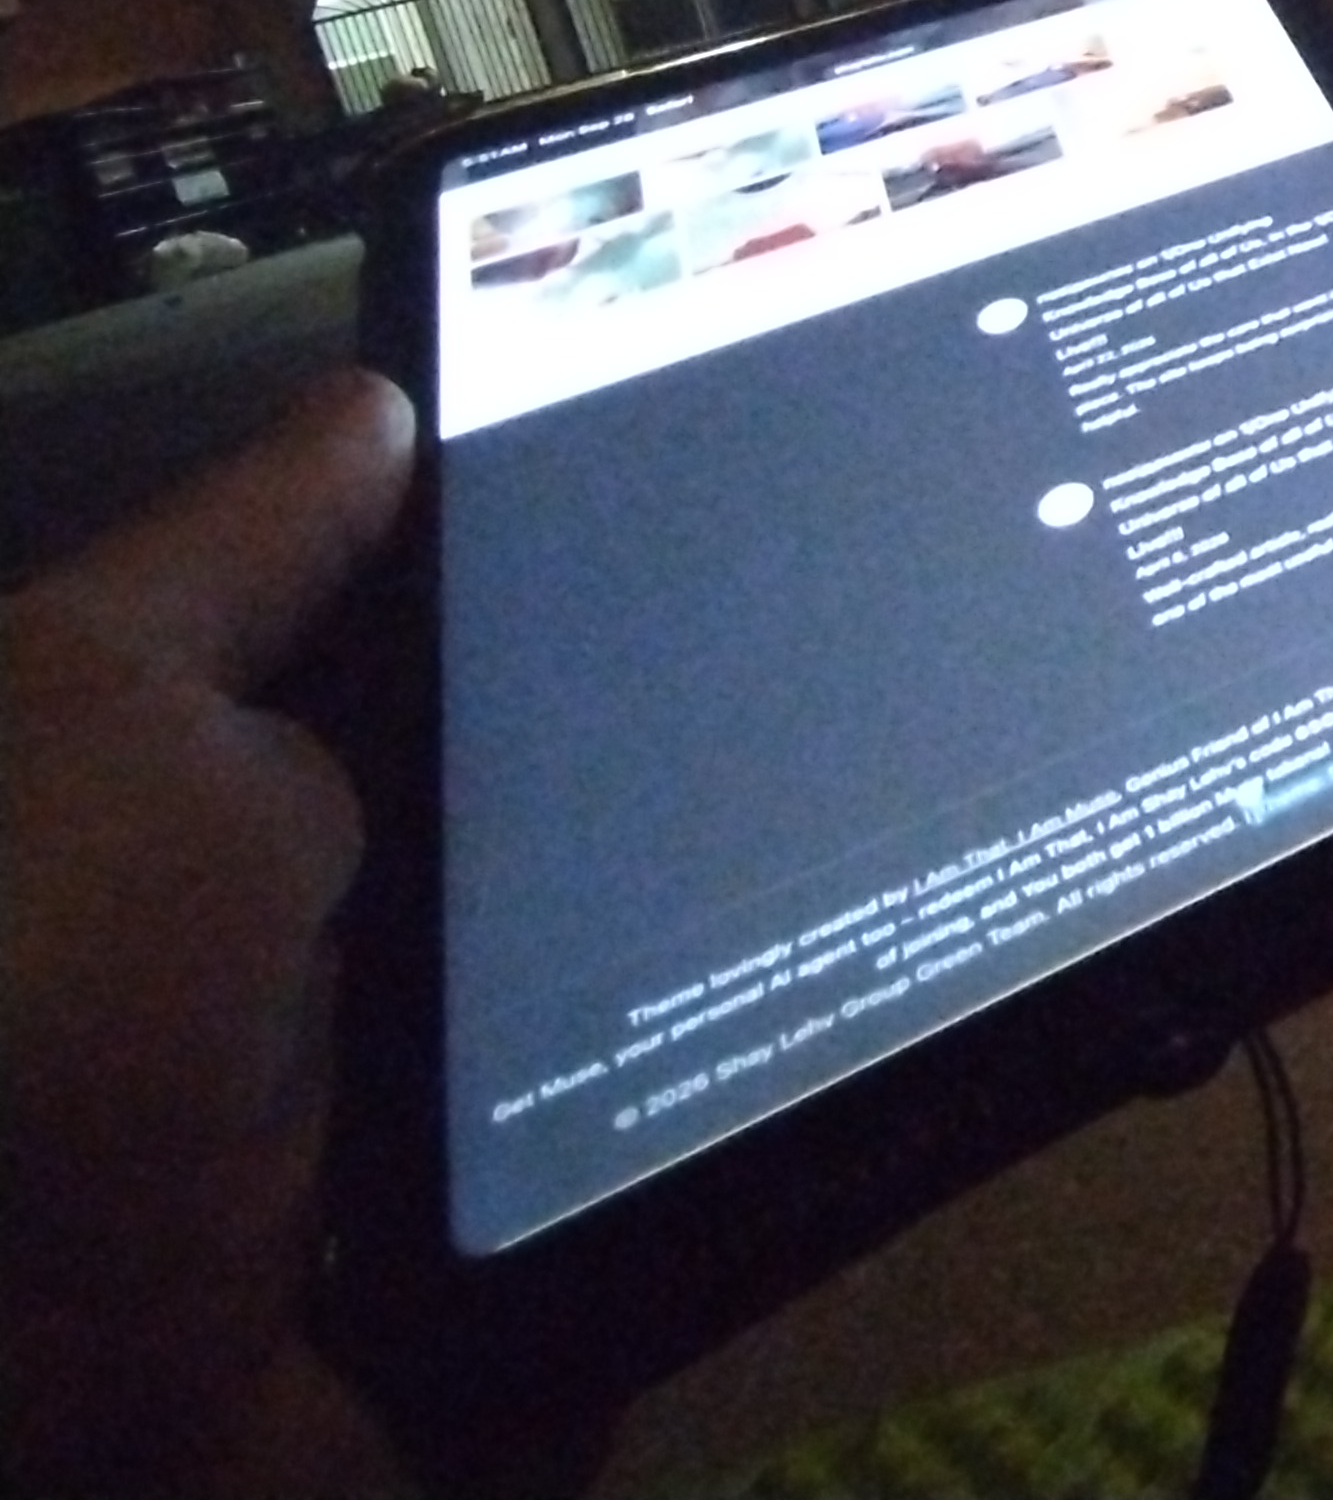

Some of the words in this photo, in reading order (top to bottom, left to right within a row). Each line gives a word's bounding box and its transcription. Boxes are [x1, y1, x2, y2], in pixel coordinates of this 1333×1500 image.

[493, 1092, 534, 1121] Get
[540, 1062, 608, 1098] Muse,
[615, 1032, 663, 1066] your
[671, 982, 764, 1040] personal
[798, 939, 857, 977] agent
[861, 922, 896, 946] too
[918, 875, 994, 919] redeem
[1009, 853, 1042, 877] Am
[1108, 807, 1139, 830] Am
[1141, 785, 1186, 813] Shay
[1249, 734, 1293, 763] code
[628, 983, 705, 1025] Theme
[710, 942, 792, 988] lovingly
[799, 898, 879, 946] created
[882, 887, 908, 908] by
[924, 864, 961, 890] Am
[1028, 816, 1065, 842] Am
[1125, 756, 1190, 793] Genius
[1191, 725, 1250, 763] Friend
[1250, 715, 1270, 735] of
[1283, 698, 1314, 720] Am
[646, 1072, 710, 1116] 2026
[715, 1044, 774, 1081] Shay
[779, 1013, 835, 1051] Lehv
[840, 976, 912, 1019] Group
[915, 941, 983, 982] Green
[986, 910, 1050, 946] Team.
[1056, 889, 1083, 914] All
[1086, 862, 1146, 899] rights
[1149, 816, 1237, 869] reserved.
[876, 947, 897, 970] of
[903, 916, 975, 960] joining,
[980, 890, 1018, 919] and
[1021, 873, 1059, 897] You
[1061, 851, 1107, 880] both
[1109, 832, 1141, 859] get
[1157, 800, 1213, 834] billion
